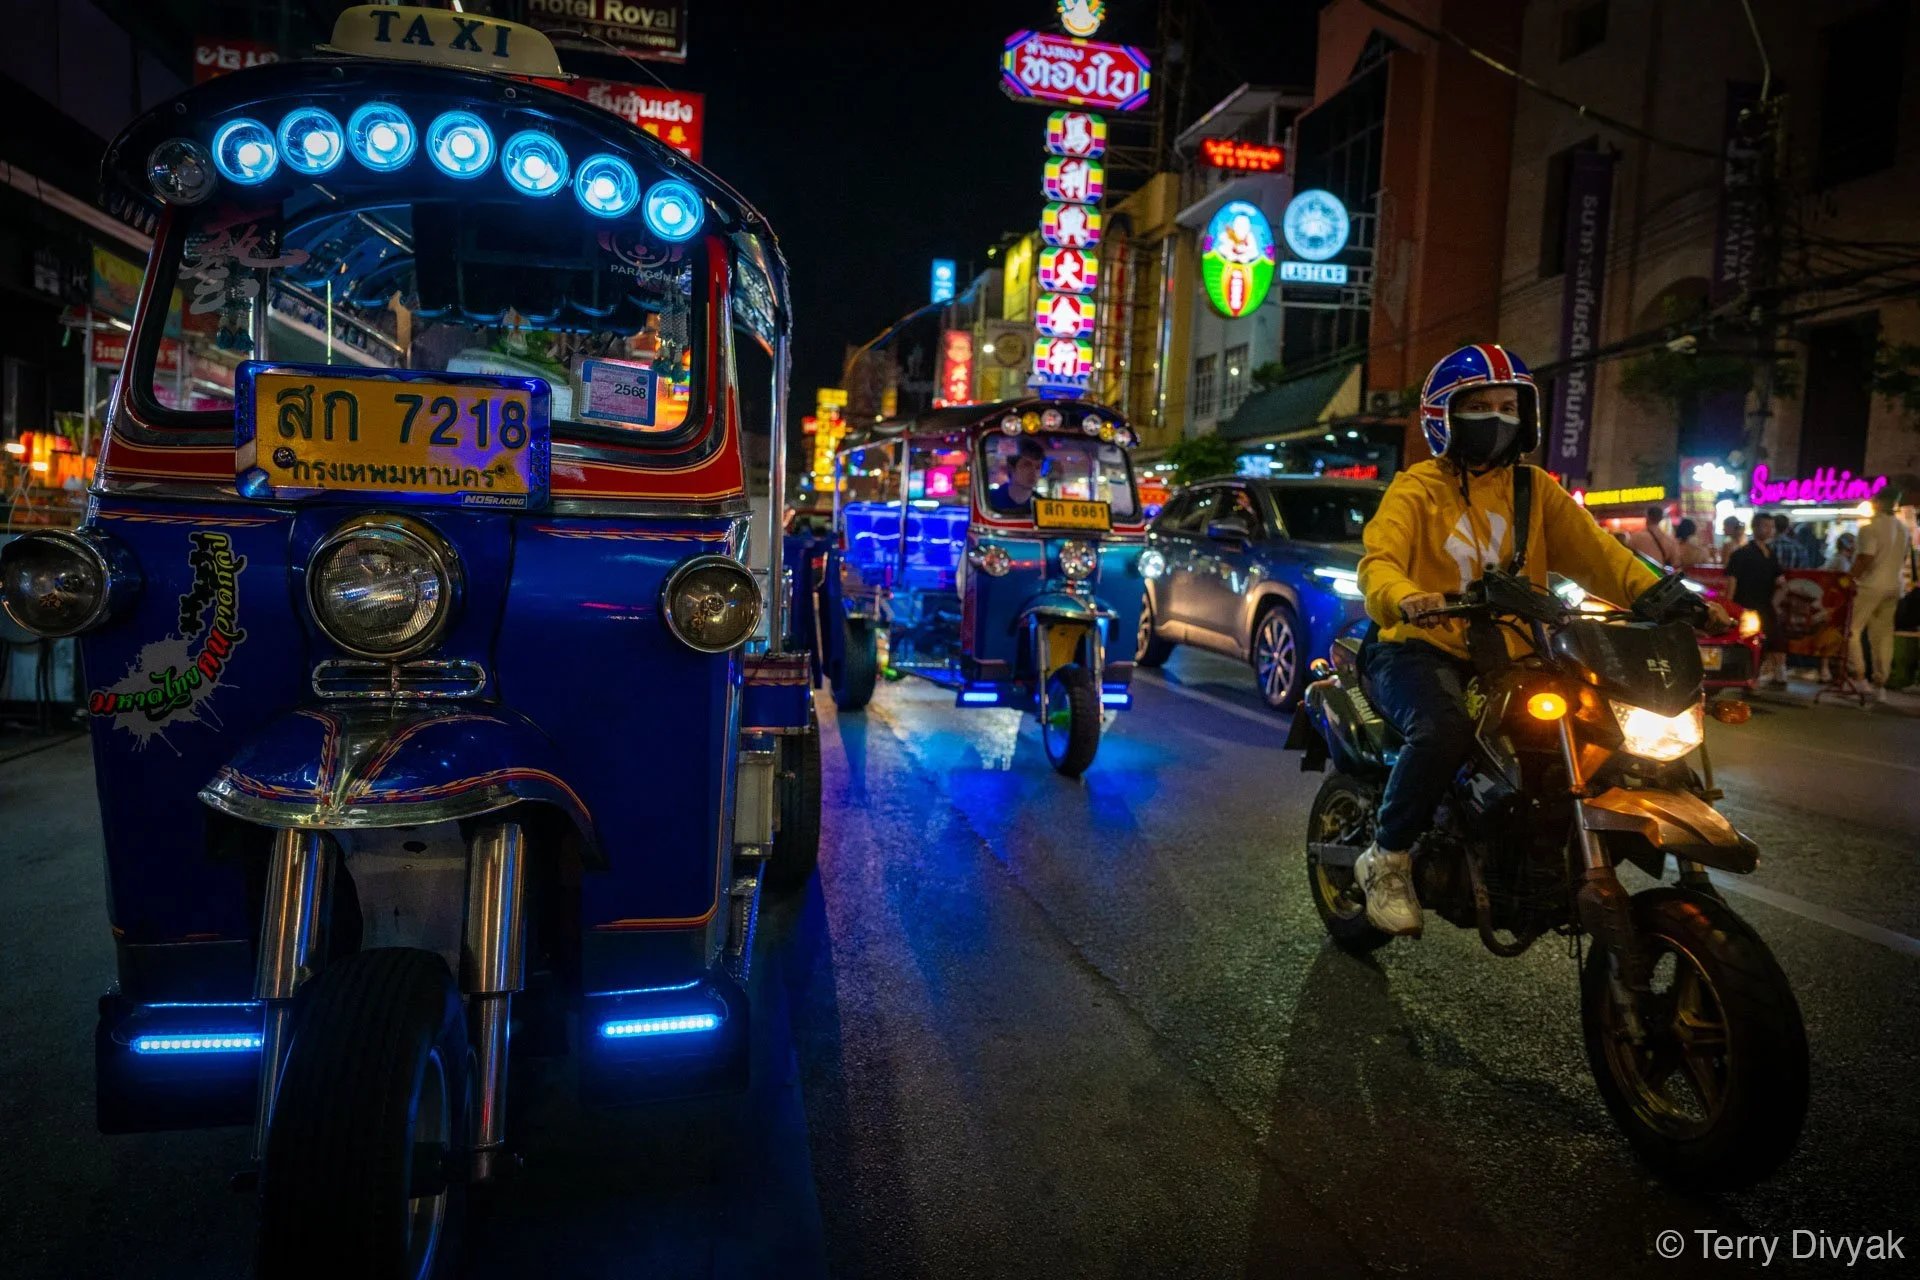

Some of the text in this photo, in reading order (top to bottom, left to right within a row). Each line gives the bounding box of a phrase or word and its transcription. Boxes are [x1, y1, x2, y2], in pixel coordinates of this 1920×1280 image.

[528, 0, 597, 19] Hotel
[604, 0, 677, 29] Royal
[369, 10, 511, 58] TAXI
[1020, 51, 1136, 101] ทองใบ
[610, 265, 673, 284] PARAGON
[614, 383, 646, 399] 2568
[276, 384, 528, 450] สก 7218
[291, 458, 497, 489] กรุงเทพมหานคร
